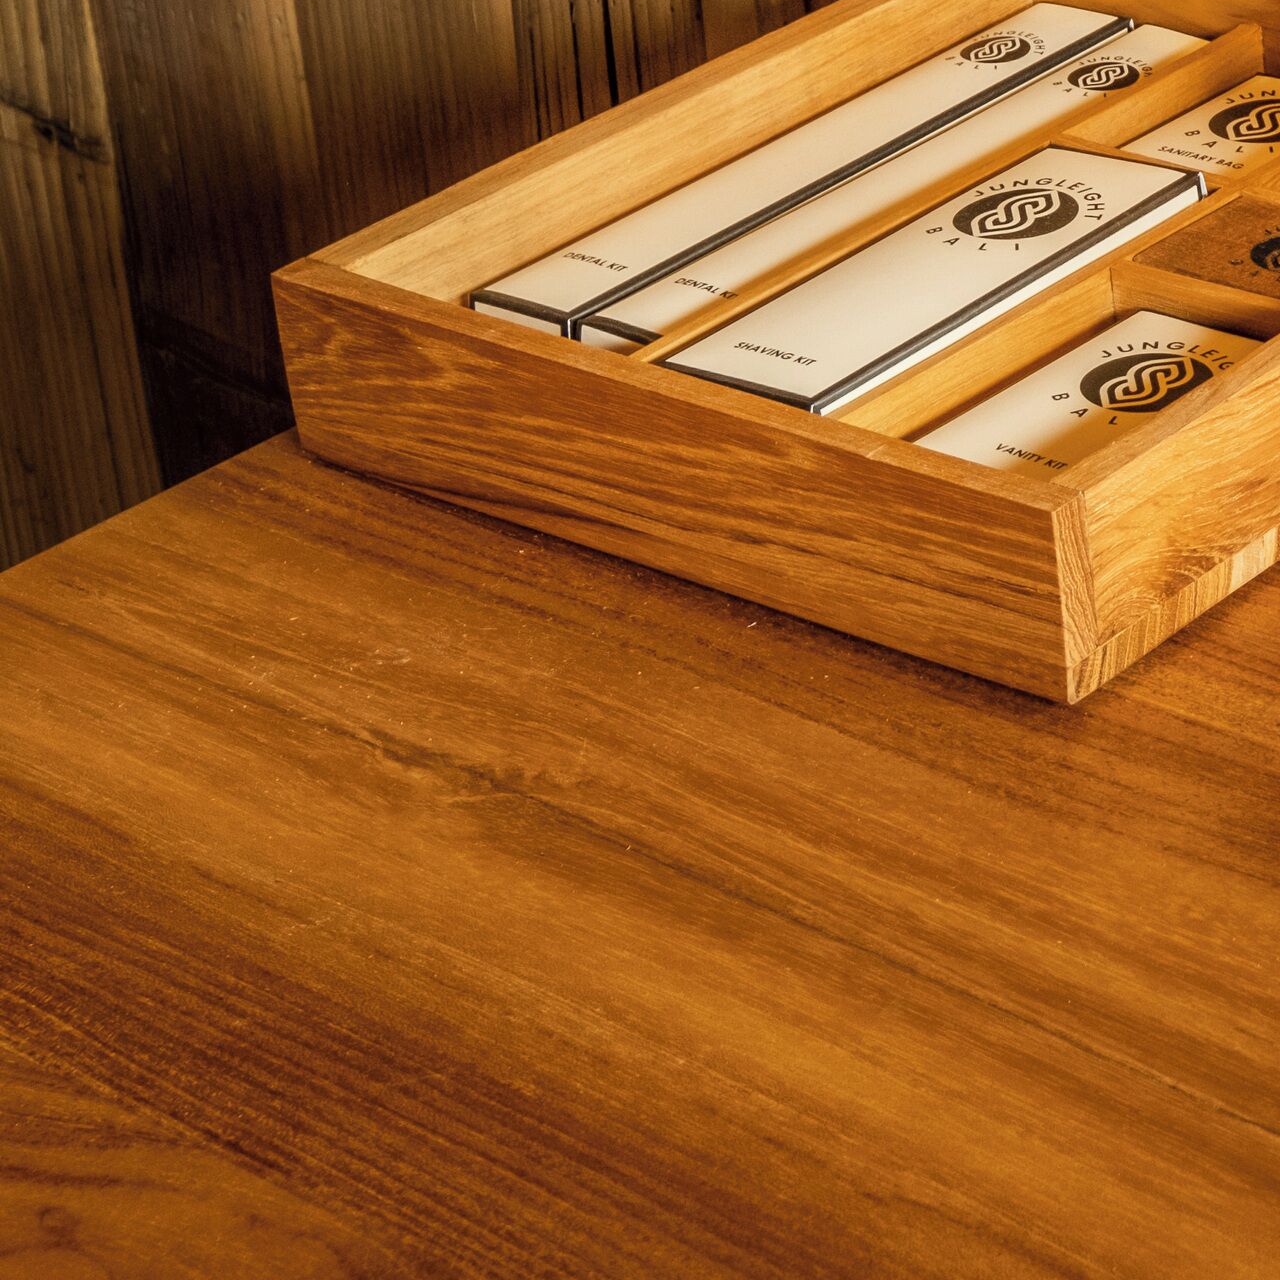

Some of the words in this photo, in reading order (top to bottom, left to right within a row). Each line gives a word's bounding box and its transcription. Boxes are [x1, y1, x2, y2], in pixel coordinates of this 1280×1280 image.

[974, 30, 1047, 55] JUNGLEIGHT
[1052, 81, 1107, 98] BALI
[1184, 130, 1274, 154] BALI
[1157, 145, 1218, 163] SANITARY
[1216, 158, 1245, 170] BAG
[973, 177, 1106, 221] JUNGLEIGHT
[925, 226, 1020, 251] BALI
[563, 251, 608, 267] DENTAL
[606, 262, 629, 273] KIT
[674, 277, 719, 294] DENTAL
[733, 341, 795, 361] SHAVING
[793, 355, 818, 367] KIT
[1051, 392, 1119, 426] BAL
[995, 443, 1044, 463] VANITY
[1045, 458, 1069, 471] KIT
